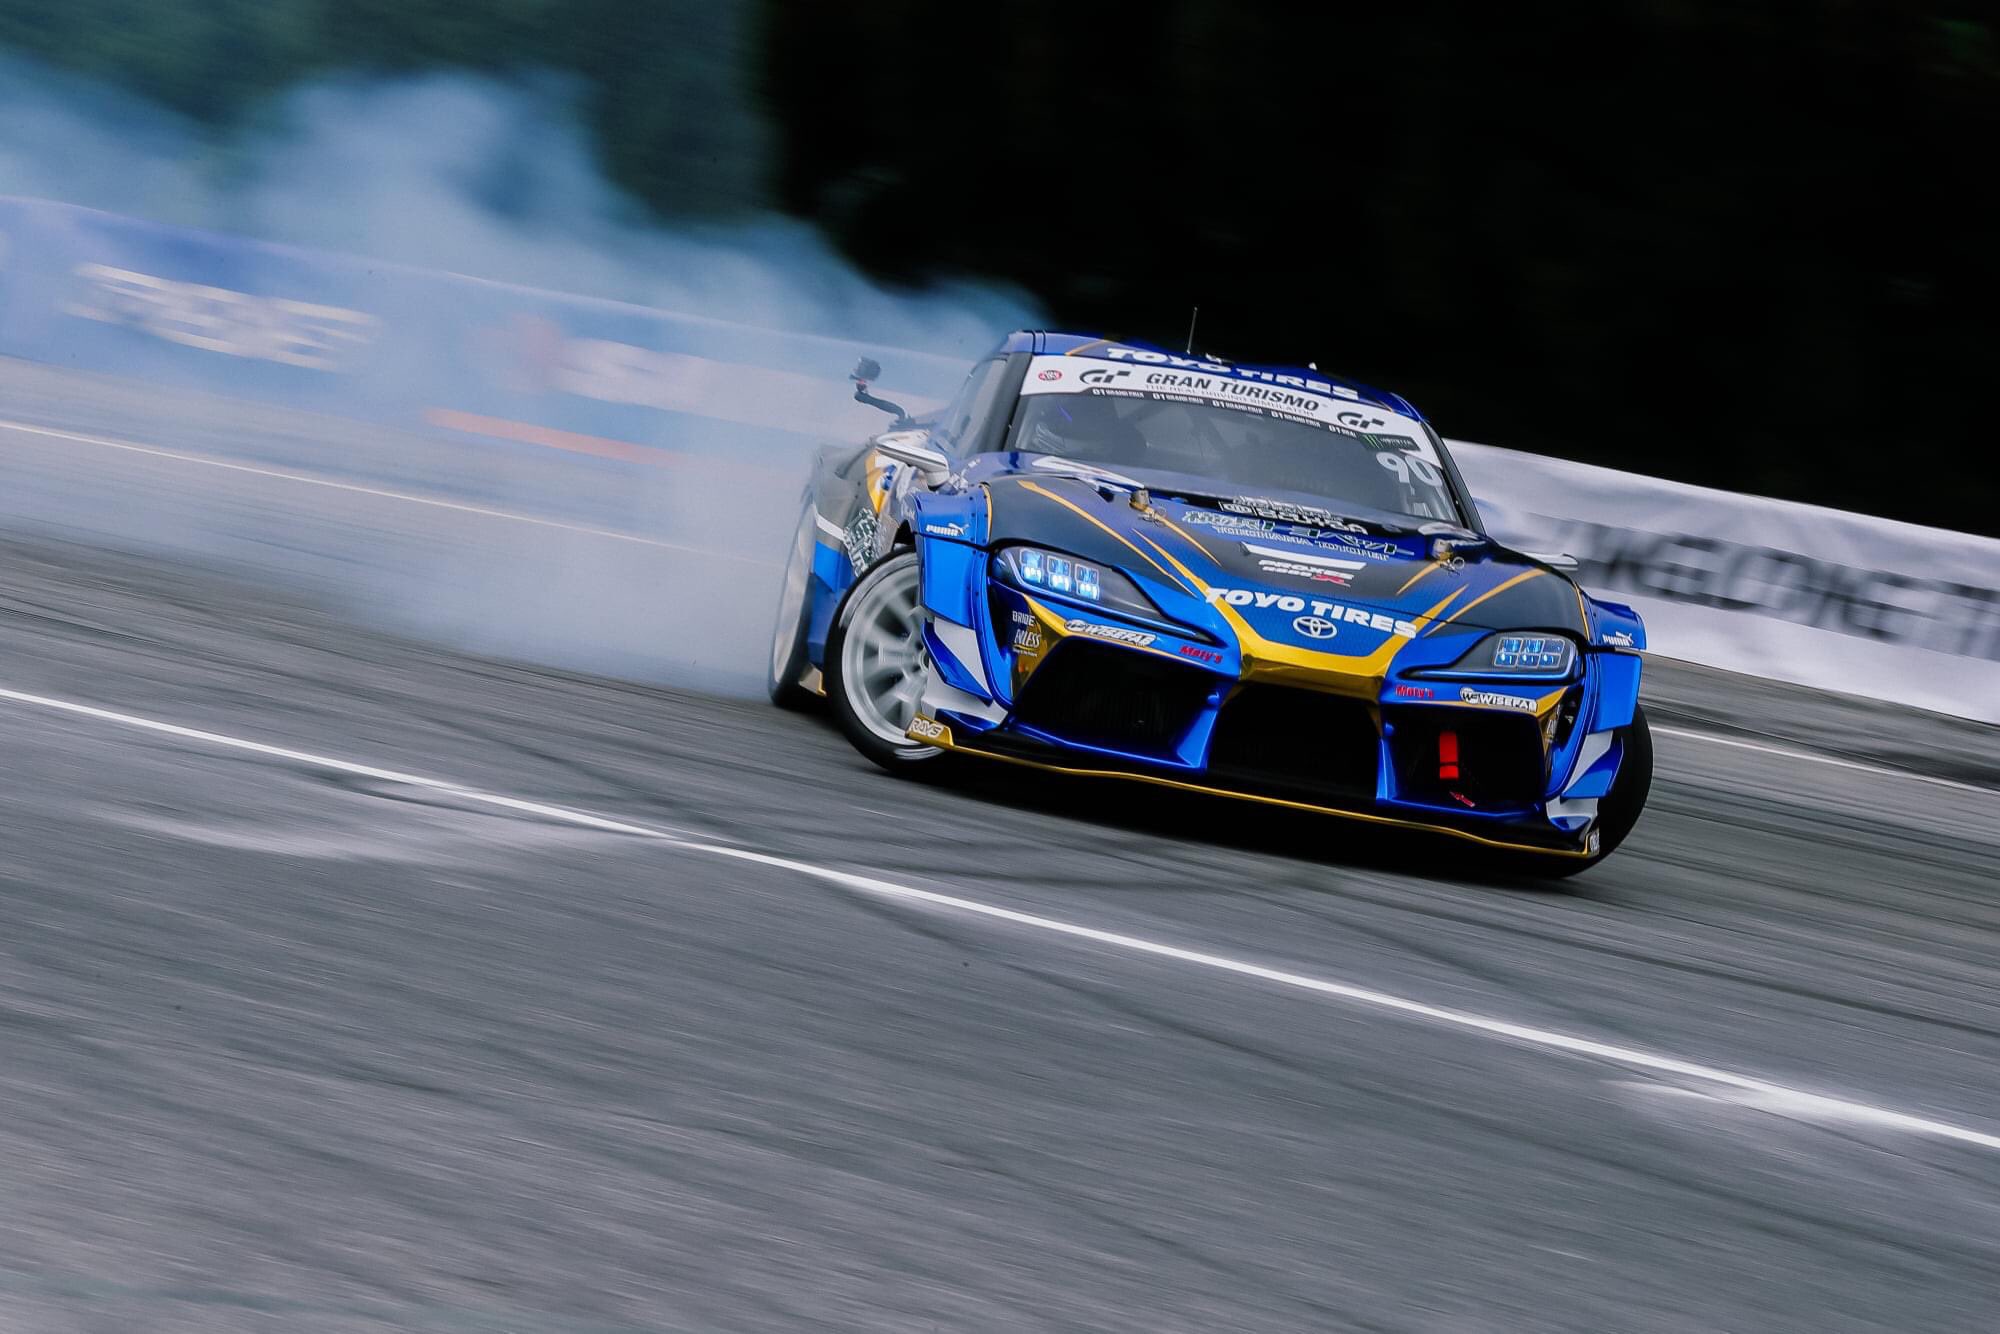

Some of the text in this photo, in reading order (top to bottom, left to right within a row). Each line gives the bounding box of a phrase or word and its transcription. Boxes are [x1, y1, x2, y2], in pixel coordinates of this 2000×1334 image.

[1107, 348, 1359, 400] TOYO TIRES
[1145, 372, 1320, 411] GRAN TURISMO
[1376, 452, 1443, 487] 90
[1012, 610, 1035, 627] BRIDE
[1205, 587, 1417, 639] TOYO TIRES
[1085, 624, 1156, 645] WISEFAB
[911, 717, 944, 738] RAYS
